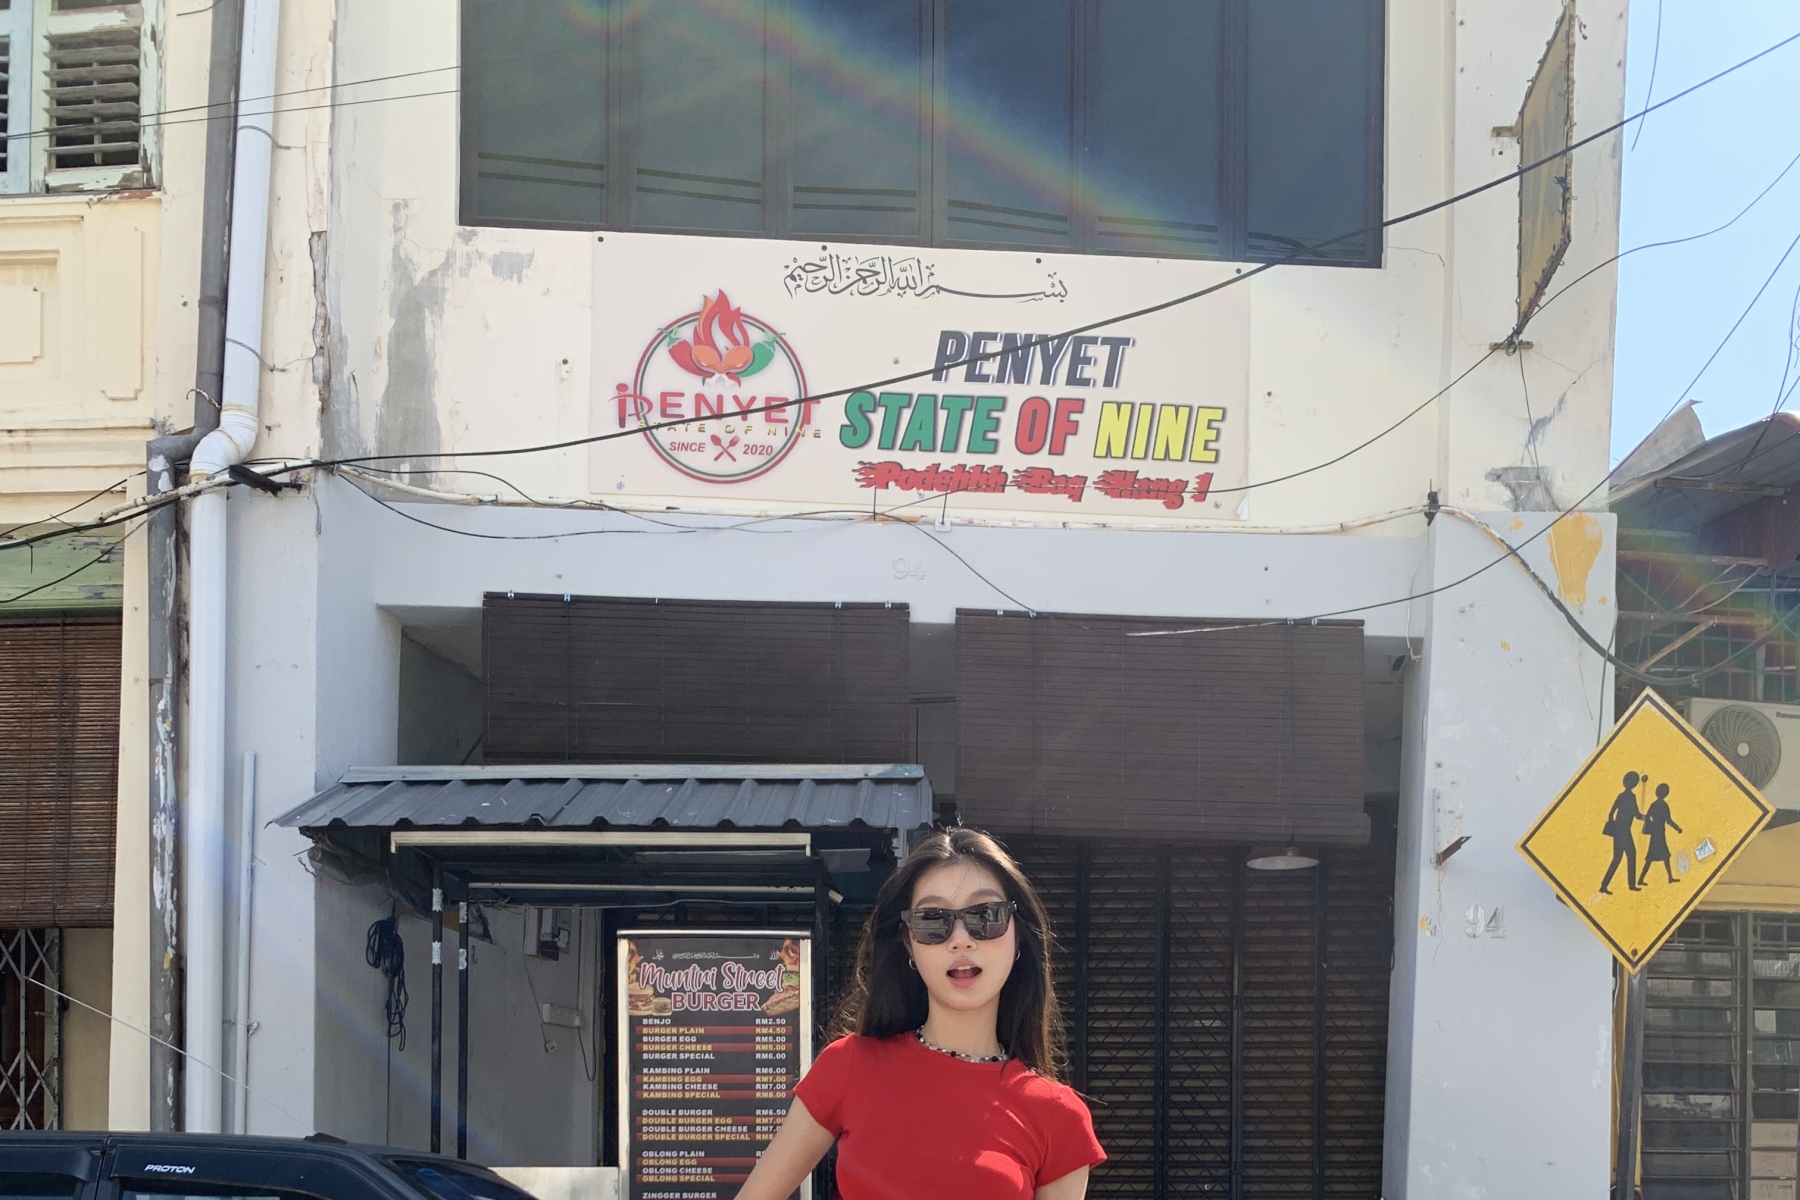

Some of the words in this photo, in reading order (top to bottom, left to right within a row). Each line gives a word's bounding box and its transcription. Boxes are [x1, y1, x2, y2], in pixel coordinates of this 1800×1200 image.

[932, 330, 1136, 390] PENYET
[839, 390, 1007, 453] STATE
[1014, 396, 1085, 456] OF
[1093, 401, 1226, 463] NINE
[723, 424, 753, 435] OF
[767, 426, 822, 439] NINE
[669, 441, 706, 453] SINCE
[743, 444, 773, 456] 2020
[1464, 904, 1506, 938] 94
[640, 962, 717, 993] Muntri
[721, 961, 786, 992] Street
[671, 992, 761, 1011] BURGER
[642, 1017, 672, 1026] BENJO
[755, 1017, 787, 1026] RM2.50
[642, 1026, 678, 1035] BURGER
[679, 1026, 705, 1035] PLAIN
[755, 1026, 787, 1035] RM4.50
[642, 1035, 678, 1043] BURGER
[679, 1035, 697, 1043] EGG
[755, 1035, 787, 1043] RM5.00
[642, 1044, 678, 1052] BURGER
[679, 1044, 713, 1052] CHEESE
[755, 1044, 787, 1052] RM5.00
[642, 1052, 678, 1060] BURGER
[679, 1052, 716, 1060] SPECIAL
[755, 1052, 787, 1060] RM6.00
[642, 1066, 683, 1075] KAMBING
[684, 1066, 711, 1075] PLAIN
[755, 1066, 787, 1075] RM6.00
[642, 1075, 683, 1083] KAMBING
[684, 1075, 703, 1083] EGG
[755, 1075, 787, 1083] RM7.00
[642, 1083, 683, 1091] KAMBING
[684, 1083, 719, 1091] CHEESE
[755, 1083, 787, 1091] RM7.00
[642, 1091, 683, 1099] KAMBING
[684, 1091, 721, 1099] SPECIAL
[755, 1091, 787, 1099] RM8.00
[642, 1108, 677, 1117] DOUBLE
[678, 1108, 713, 1117] BURGER
[755, 1108, 787, 1117] RM6.50
[642, 1116, 677, 1125] DOUBLE
[678, 1116, 713, 1125] BURGER
[714, 1116, 733, 1125] EGG
[642, 1125, 677, 1133] DOUBLE
[678, 1125, 713, 1133] BURGER
[714, 1125, 749, 1133] CHEESE
[755, 1125, 781, 1133] RM7.0
[642, 1133, 677, 1141] DOUBLE
[678, 1133, 713, 1141] BURGER
[714, 1133, 751, 1141] SPECIAL
[642, 1150, 678, 1158] OBLONG
[679, 1150, 705, 1158] PLAIN
[642, 1158, 678, 1166] OBLONG
[679, 1158, 698, 1166] EGG
[144, 1164, 195, 1174] PROTON
[642, 1167, 678, 1175] OBLONG
[679, 1167, 713, 1175] CHEESE
[642, 1175, 678, 1183] OBLONG
[679, 1175, 716, 1183] SPECIAL
[642, 1191, 681, 1200] ZINGGER
[682, 1191, 717, 1200] BURGER
